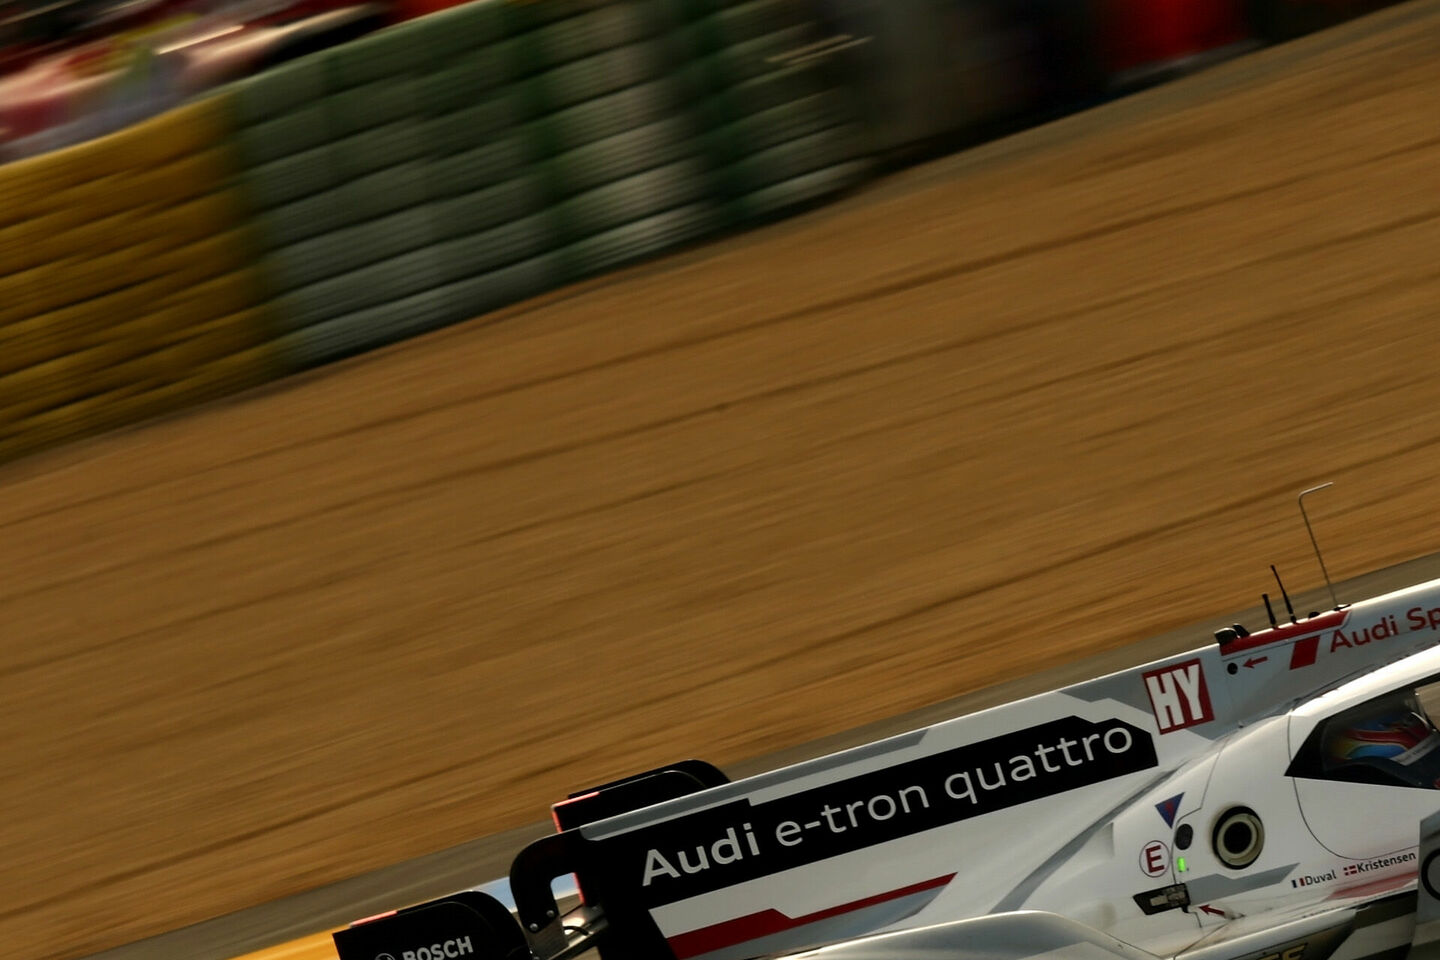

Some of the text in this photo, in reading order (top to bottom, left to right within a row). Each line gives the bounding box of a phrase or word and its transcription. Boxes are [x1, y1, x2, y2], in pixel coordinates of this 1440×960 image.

[1330, 614, 1399, 653] Audi
[1144, 663, 1204, 732] HY
[641, 724, 1134, 887] Audi e-tron quattro
[1145, 844, 1165, 873] E
[1356, 851, 1417, 874] Kristensen
[1304, 869, 1337, 886] Duval
